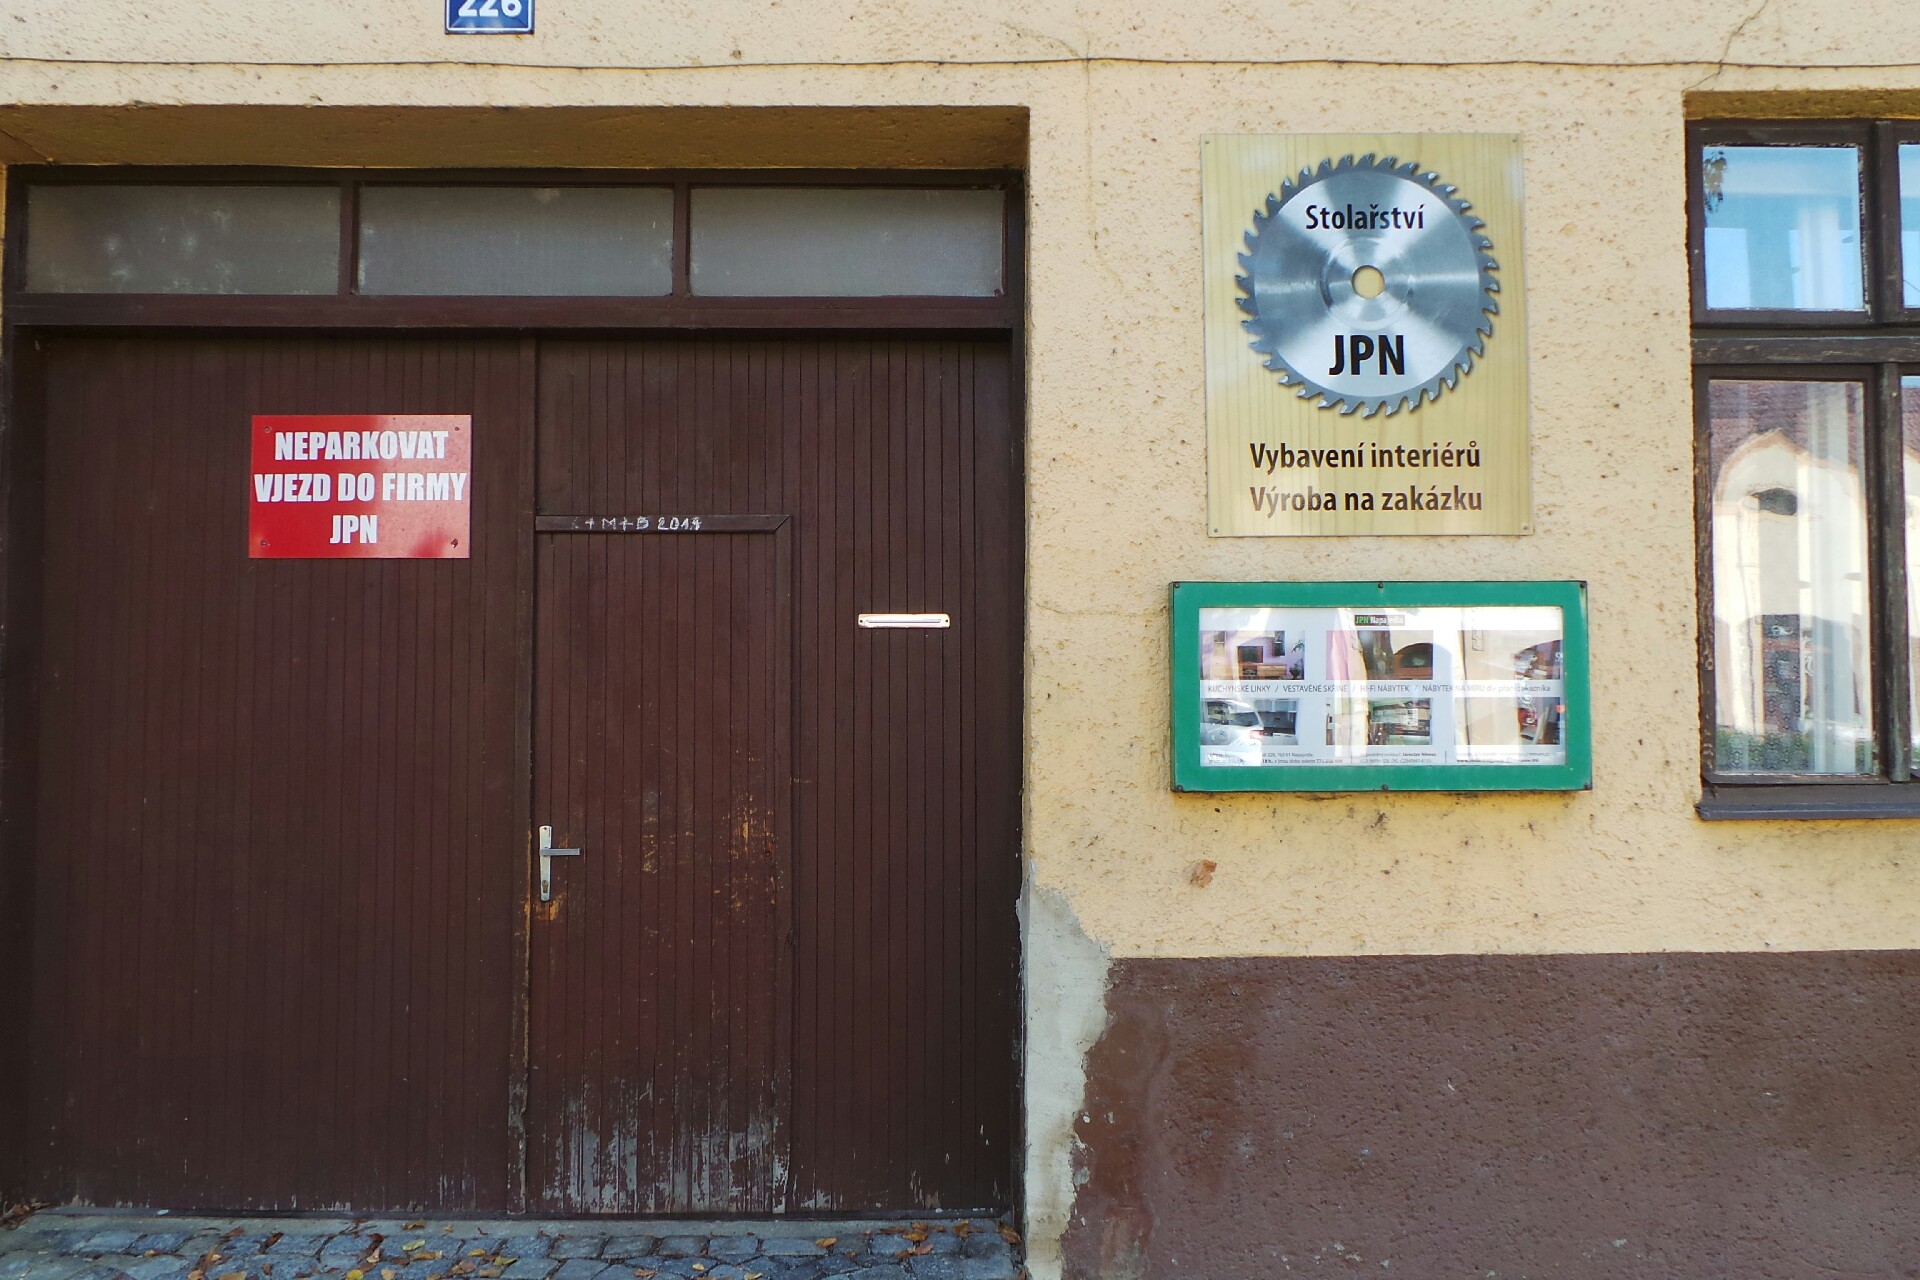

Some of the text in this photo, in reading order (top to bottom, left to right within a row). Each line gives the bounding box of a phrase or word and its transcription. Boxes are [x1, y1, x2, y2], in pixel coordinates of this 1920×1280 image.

[458, 0, 522, 17] 226
[1305, 203, 1425, 230] Stolařství
[1328, 334, 1405, 376] JPN
[274, 430, 449, 461] NEPARKOVAT
[1250, 440, 1480, 475] Vybavení interiérů
[254, 472, 467, 502] VJEZD DO FIRMY
[1250, 485, 1482, 519] Výroba na zakázku
[329, 514, 378, 544] JPN
[1356, 616, 1369, 624] JPN
[1250, 684, 1271, 693] LINKY
[1377, 684, 1410, 692] NÁBYTEK
